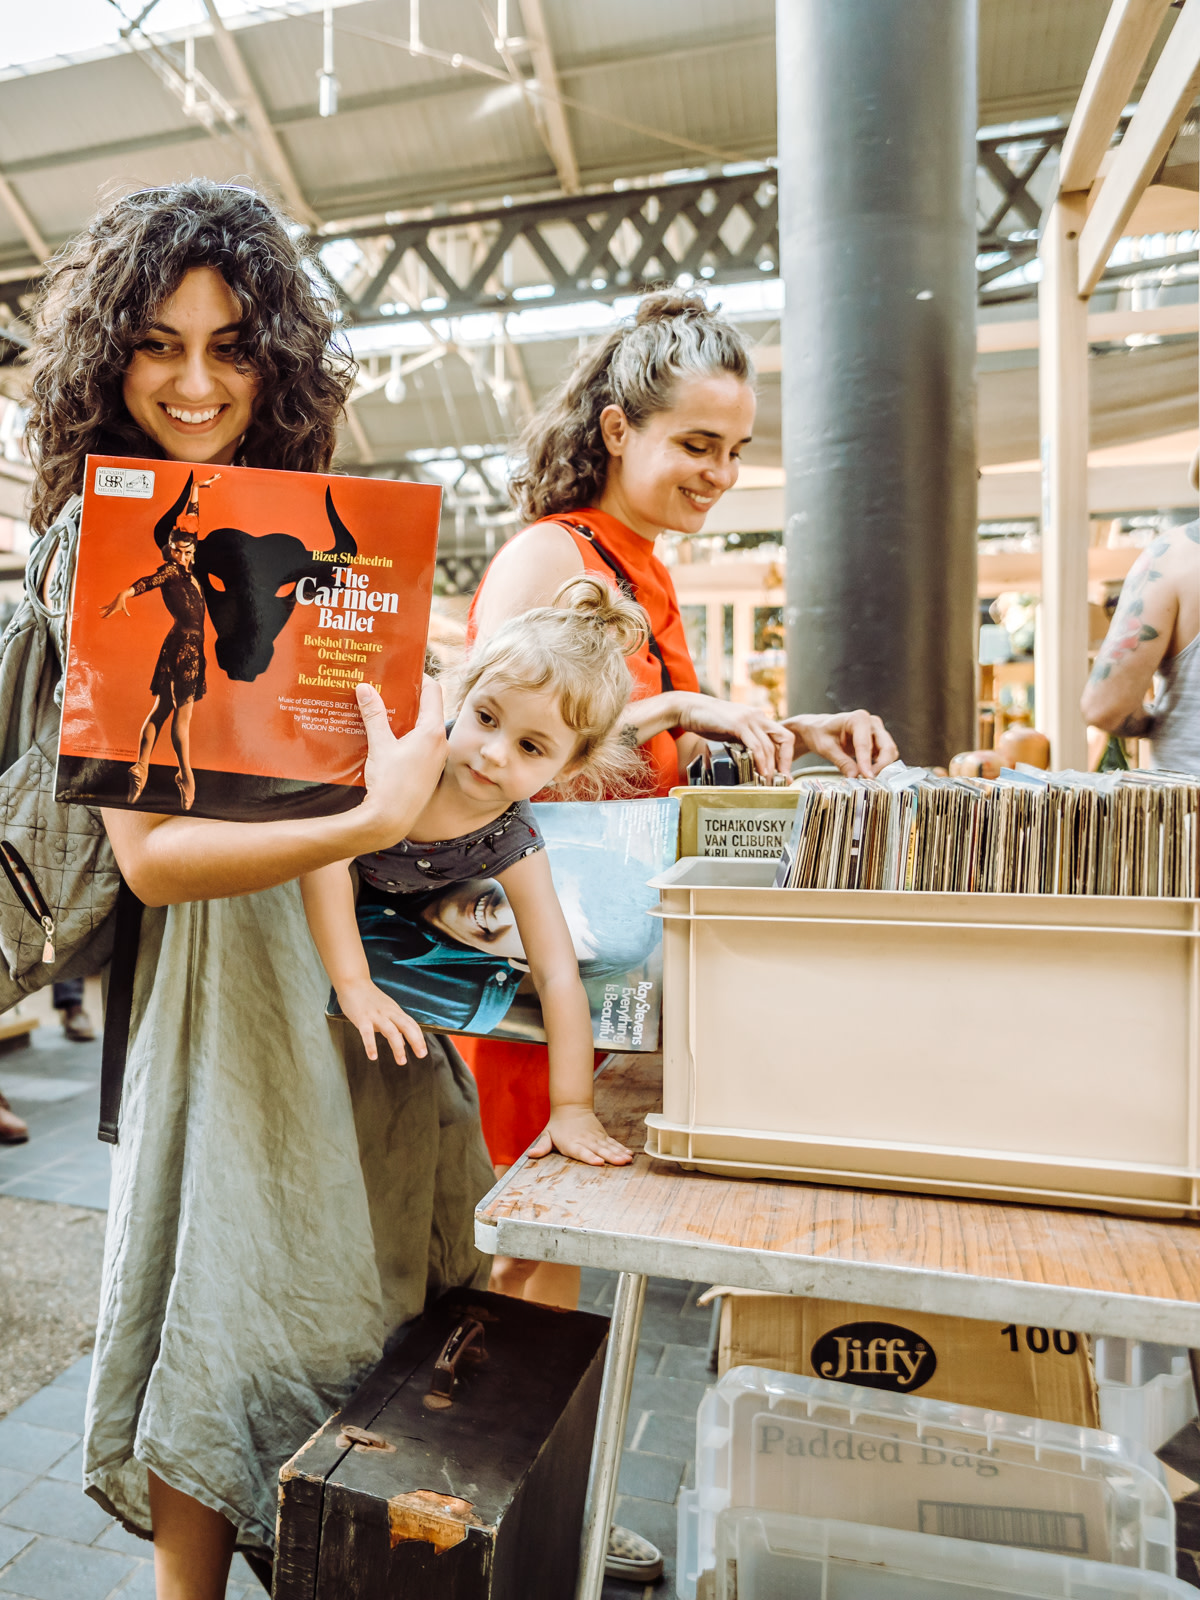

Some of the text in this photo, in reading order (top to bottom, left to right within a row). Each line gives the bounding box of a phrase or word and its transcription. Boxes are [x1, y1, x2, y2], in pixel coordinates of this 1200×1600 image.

[312, 549, 393, 568] Bizet-Shchedrin
[332, 566, 369, 589] The
[295, 576, 399, 614] Carmen
[317, 607, 376, 633] Ballet
[304, 634, 383, 653] Bolshoi Theatre
[317, 648, 367, 663] Orchestra
[318, 664, 364, 681] Gennady
[298, 673, 382, 694] Rozhdestveky
[278, 696, 294, 704] Music
[302, 699, 334, 708] GEORGES
[335, 702, 353, 710] BIZET
[288, 706, 308, 714] strings
[328, 709, 359, 718] percussion
[301, 723, 367, 735] RODION SHCHEDRIN
[311, 717, 329, 725] young
[330, 717, 348, 725] Soviet
[704, 819, 786, 832] TCHAIKOVSKY
[704, 834, 782, 848] VAN CLIBURN
[598, 983, 619, 1042] Is Beautiful
[612, 987, 636, 1044] Everything
[631, 981, 653, 1046] Ray Stevens
[1001, 1324, 1077, 1355] 100
[820, 1337, 927, 1384] Jiffy
[758, 1425, 1000, 1477] Padded Bag
